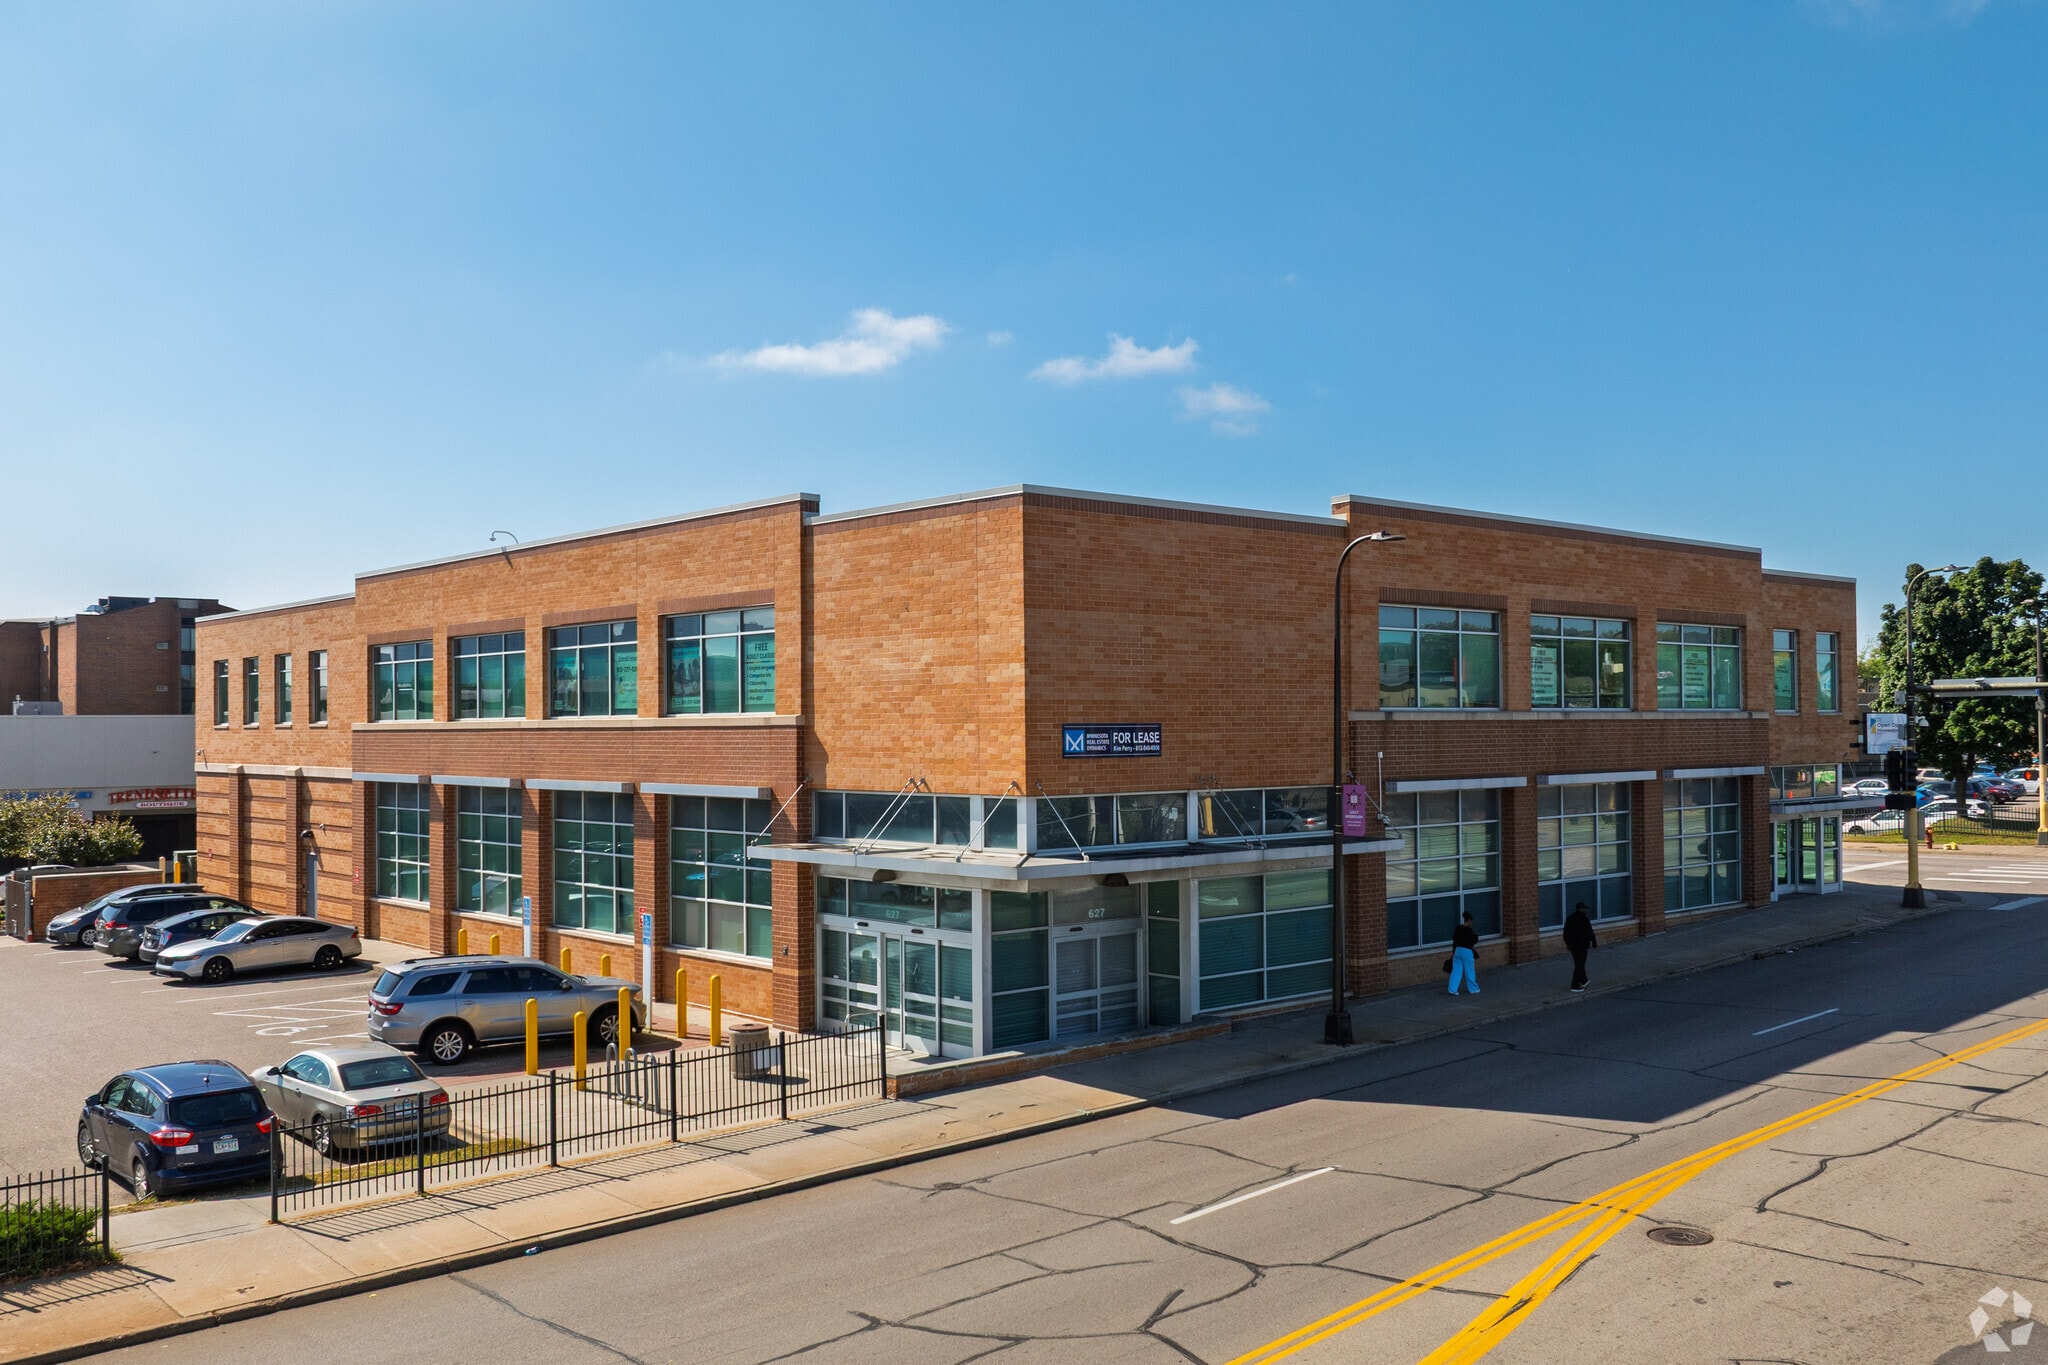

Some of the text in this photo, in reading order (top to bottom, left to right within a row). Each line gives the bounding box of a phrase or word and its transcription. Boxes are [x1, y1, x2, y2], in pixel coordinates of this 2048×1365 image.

[754, 642, 769, 651] FREE
[1113, 732, 1160, 744] FOR LEASE
[885, 909, 900, 920] 627
[1088, 907, 1106, 918] 627
